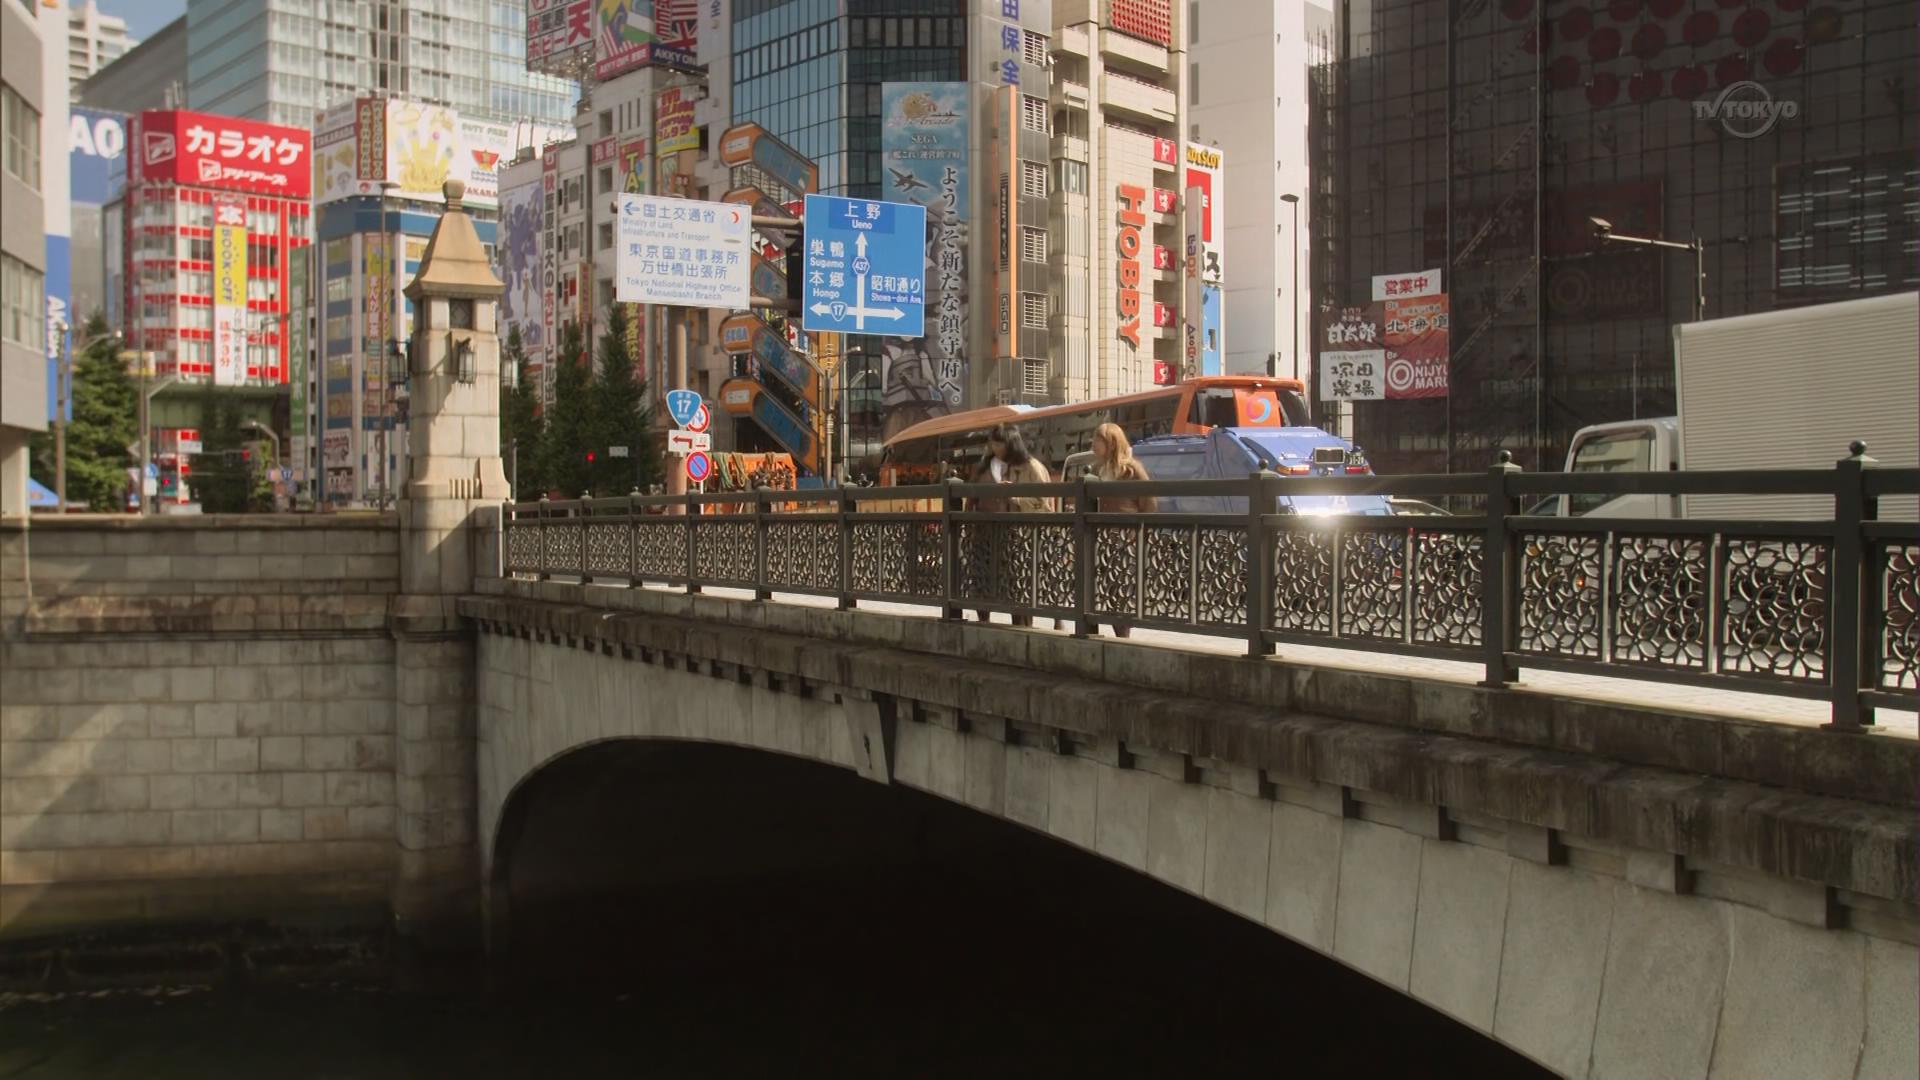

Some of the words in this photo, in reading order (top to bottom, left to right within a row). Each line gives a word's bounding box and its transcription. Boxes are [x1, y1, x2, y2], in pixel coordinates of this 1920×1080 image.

[185, 124, 304, 165] カラオケ
[911, 135, 938, 145] SEGA
[643, 203, 716, 223] 国土交通省
[844, 201, 881, 220] 上野
[852, 219, 873, 230] Ueno
[629, 243, 740, 265] 東京国道事務所
[810, 239, 845, 258] 巣鴨
[641, 260, 728, 280] 万世橋出張所
[809, 257, 845, 269] Sugamo
[1119, 183, 1147, 350] HOBBY
[626, 277, 649, 288] Tokyo
[652, 278, 684, 290] National
[685, 281, 717, 293] Highway
[809, 270, 845, 288] 本郷
[871, 274, 921, 294] 昭和通り
[1384, 276, 1429, 296] 営業中
[813, 287, 841, 299] Hongo
[832, 304, 844, 316] 17
[1326, 321, 1377, 345] 甘太郎
[676, 400, 692, 413] 17
